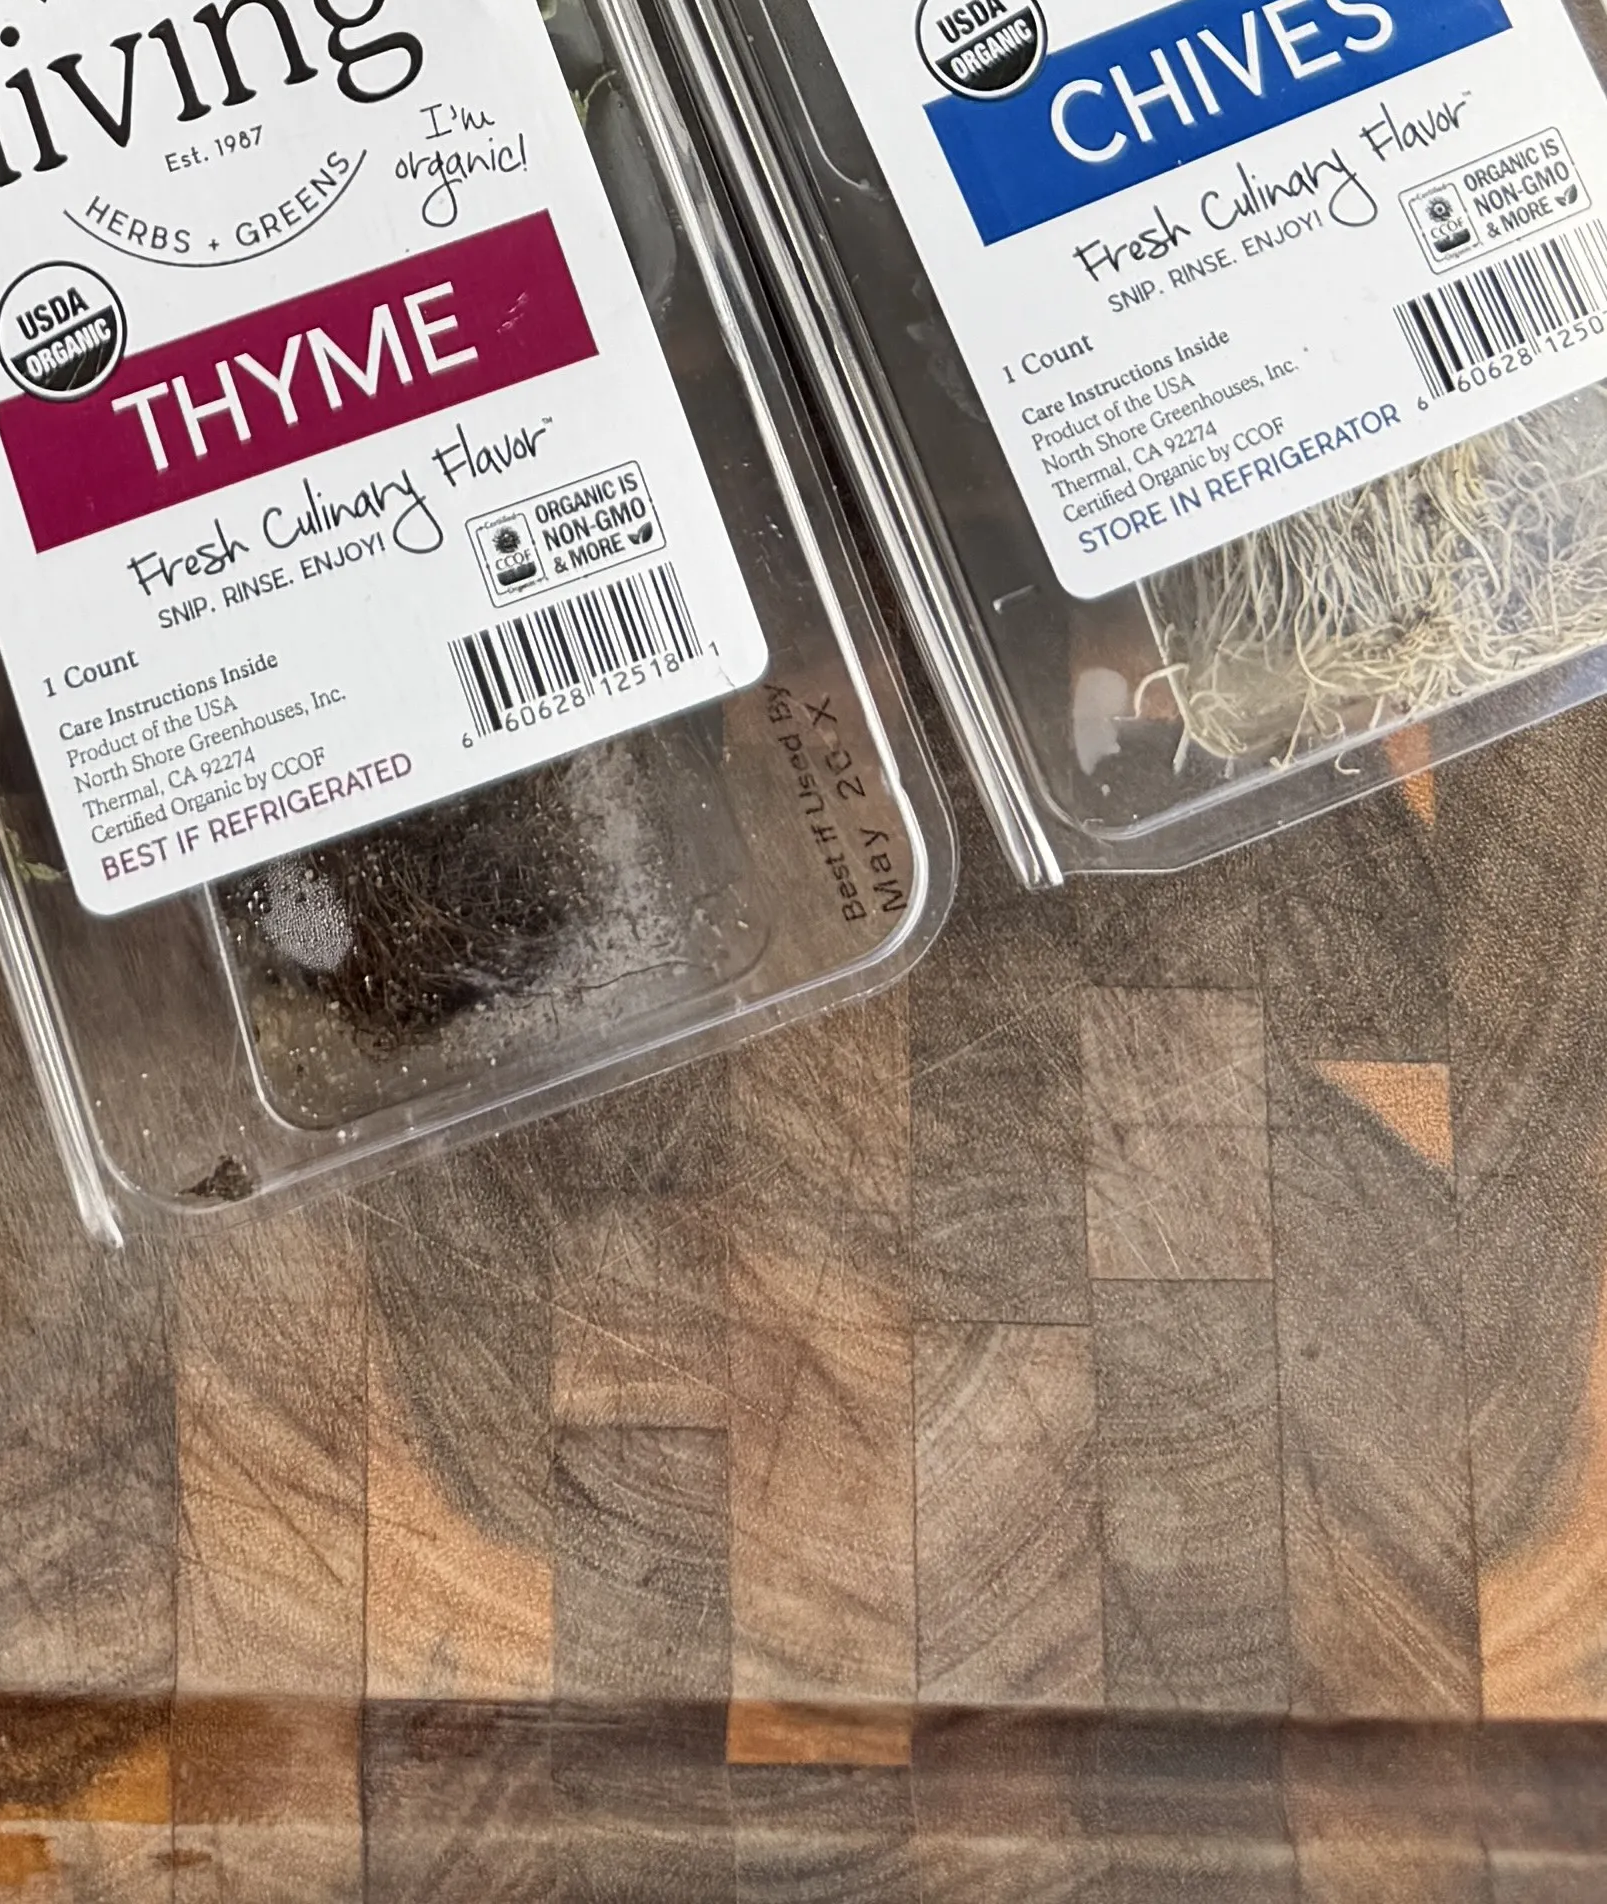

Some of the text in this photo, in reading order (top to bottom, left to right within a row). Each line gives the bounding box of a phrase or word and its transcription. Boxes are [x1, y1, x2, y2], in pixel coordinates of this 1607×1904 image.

[948, 16, 1034, 82] ORGANIC
[163, 124, 266, 174] Est. 1987
[418, 100, 497, 142] I'm
[84, 194, 193, 255] HERBS
[234, 148, 353, 249] GREENS
[393, 132, 531, 228] organic!
[1072, 101, 1465, 283] Fresh Culinary Flavor
[14, 286, 93, 342] USDA
[23, 317, 114, 381] ORGANIC
[110, 280, 480, 474] THYME
[1000, 332, 1095, 386] 1 Count
[126, 416, 549, 598] Fresh Culinary Flavor
[534, 479, 617, 524] ORGANIC
[617, 472, 639, 494] IS
[1077, 401, 1403, 556] STORE IN REFRIGERATOR
[542, 496, 646, 551] NON-GMO
[553, 532, 626, 574] & MORE
[44, 649, 140, 698] 1 Count
[73, 685, 347, 794] North Shore Greenhouses, Inc.
[777, 732, 826, 815] Used
[100, 751, 413, 882] BEST IF REFRIGERATED
[825, 852, 868, 922] Best
[858, 826, 908, 914] May
